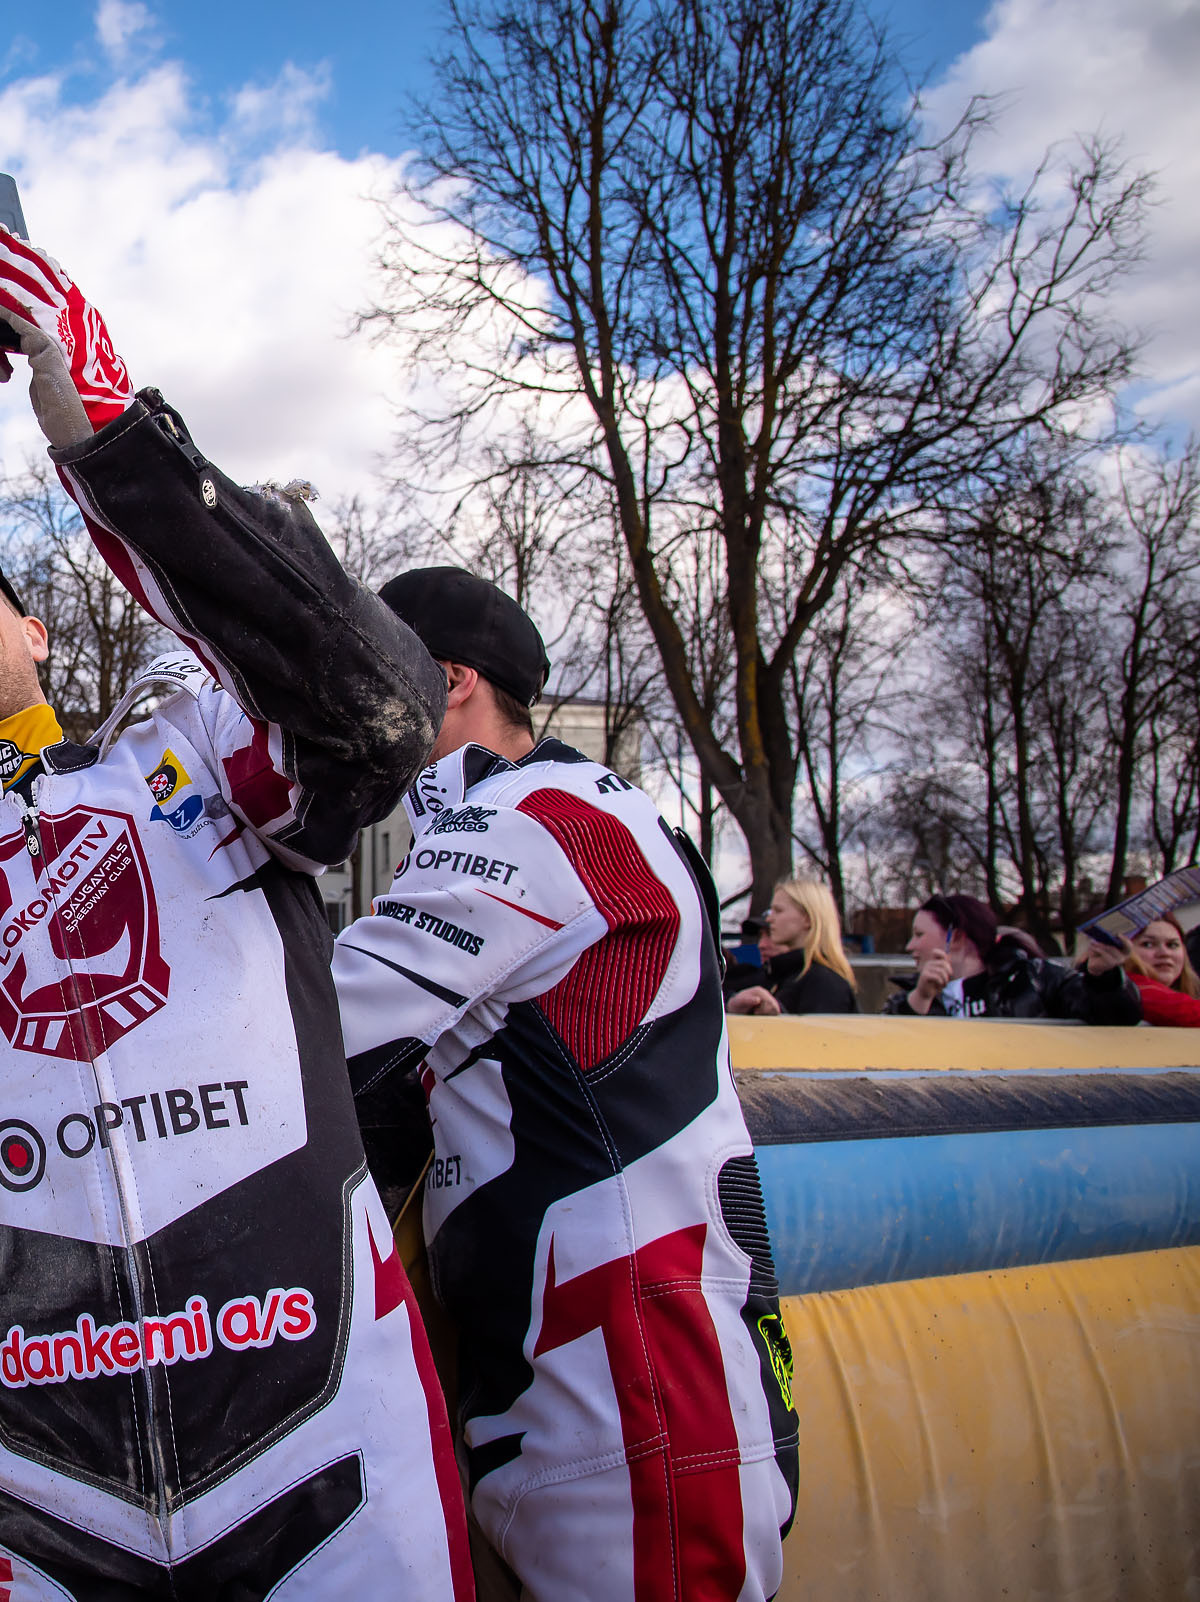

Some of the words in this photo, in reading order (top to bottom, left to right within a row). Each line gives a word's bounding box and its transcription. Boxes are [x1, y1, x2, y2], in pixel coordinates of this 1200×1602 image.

[155, 783, 175, 801] PZM
[61, 842, 128, 921] DAUGAVPILS
[65, 882, 110, 933] SPEEDWAY
[108, 856, 132, 882] CLUB
[415, 849, 520, 886] OPTIBET
[414, 911, 485, 957] STUDIOS
[56, 1080, 250, 1159] OPTIBET
[0, 1297, 211, 1386] dankemi
[219, 1290, 314, 1348] a/s
